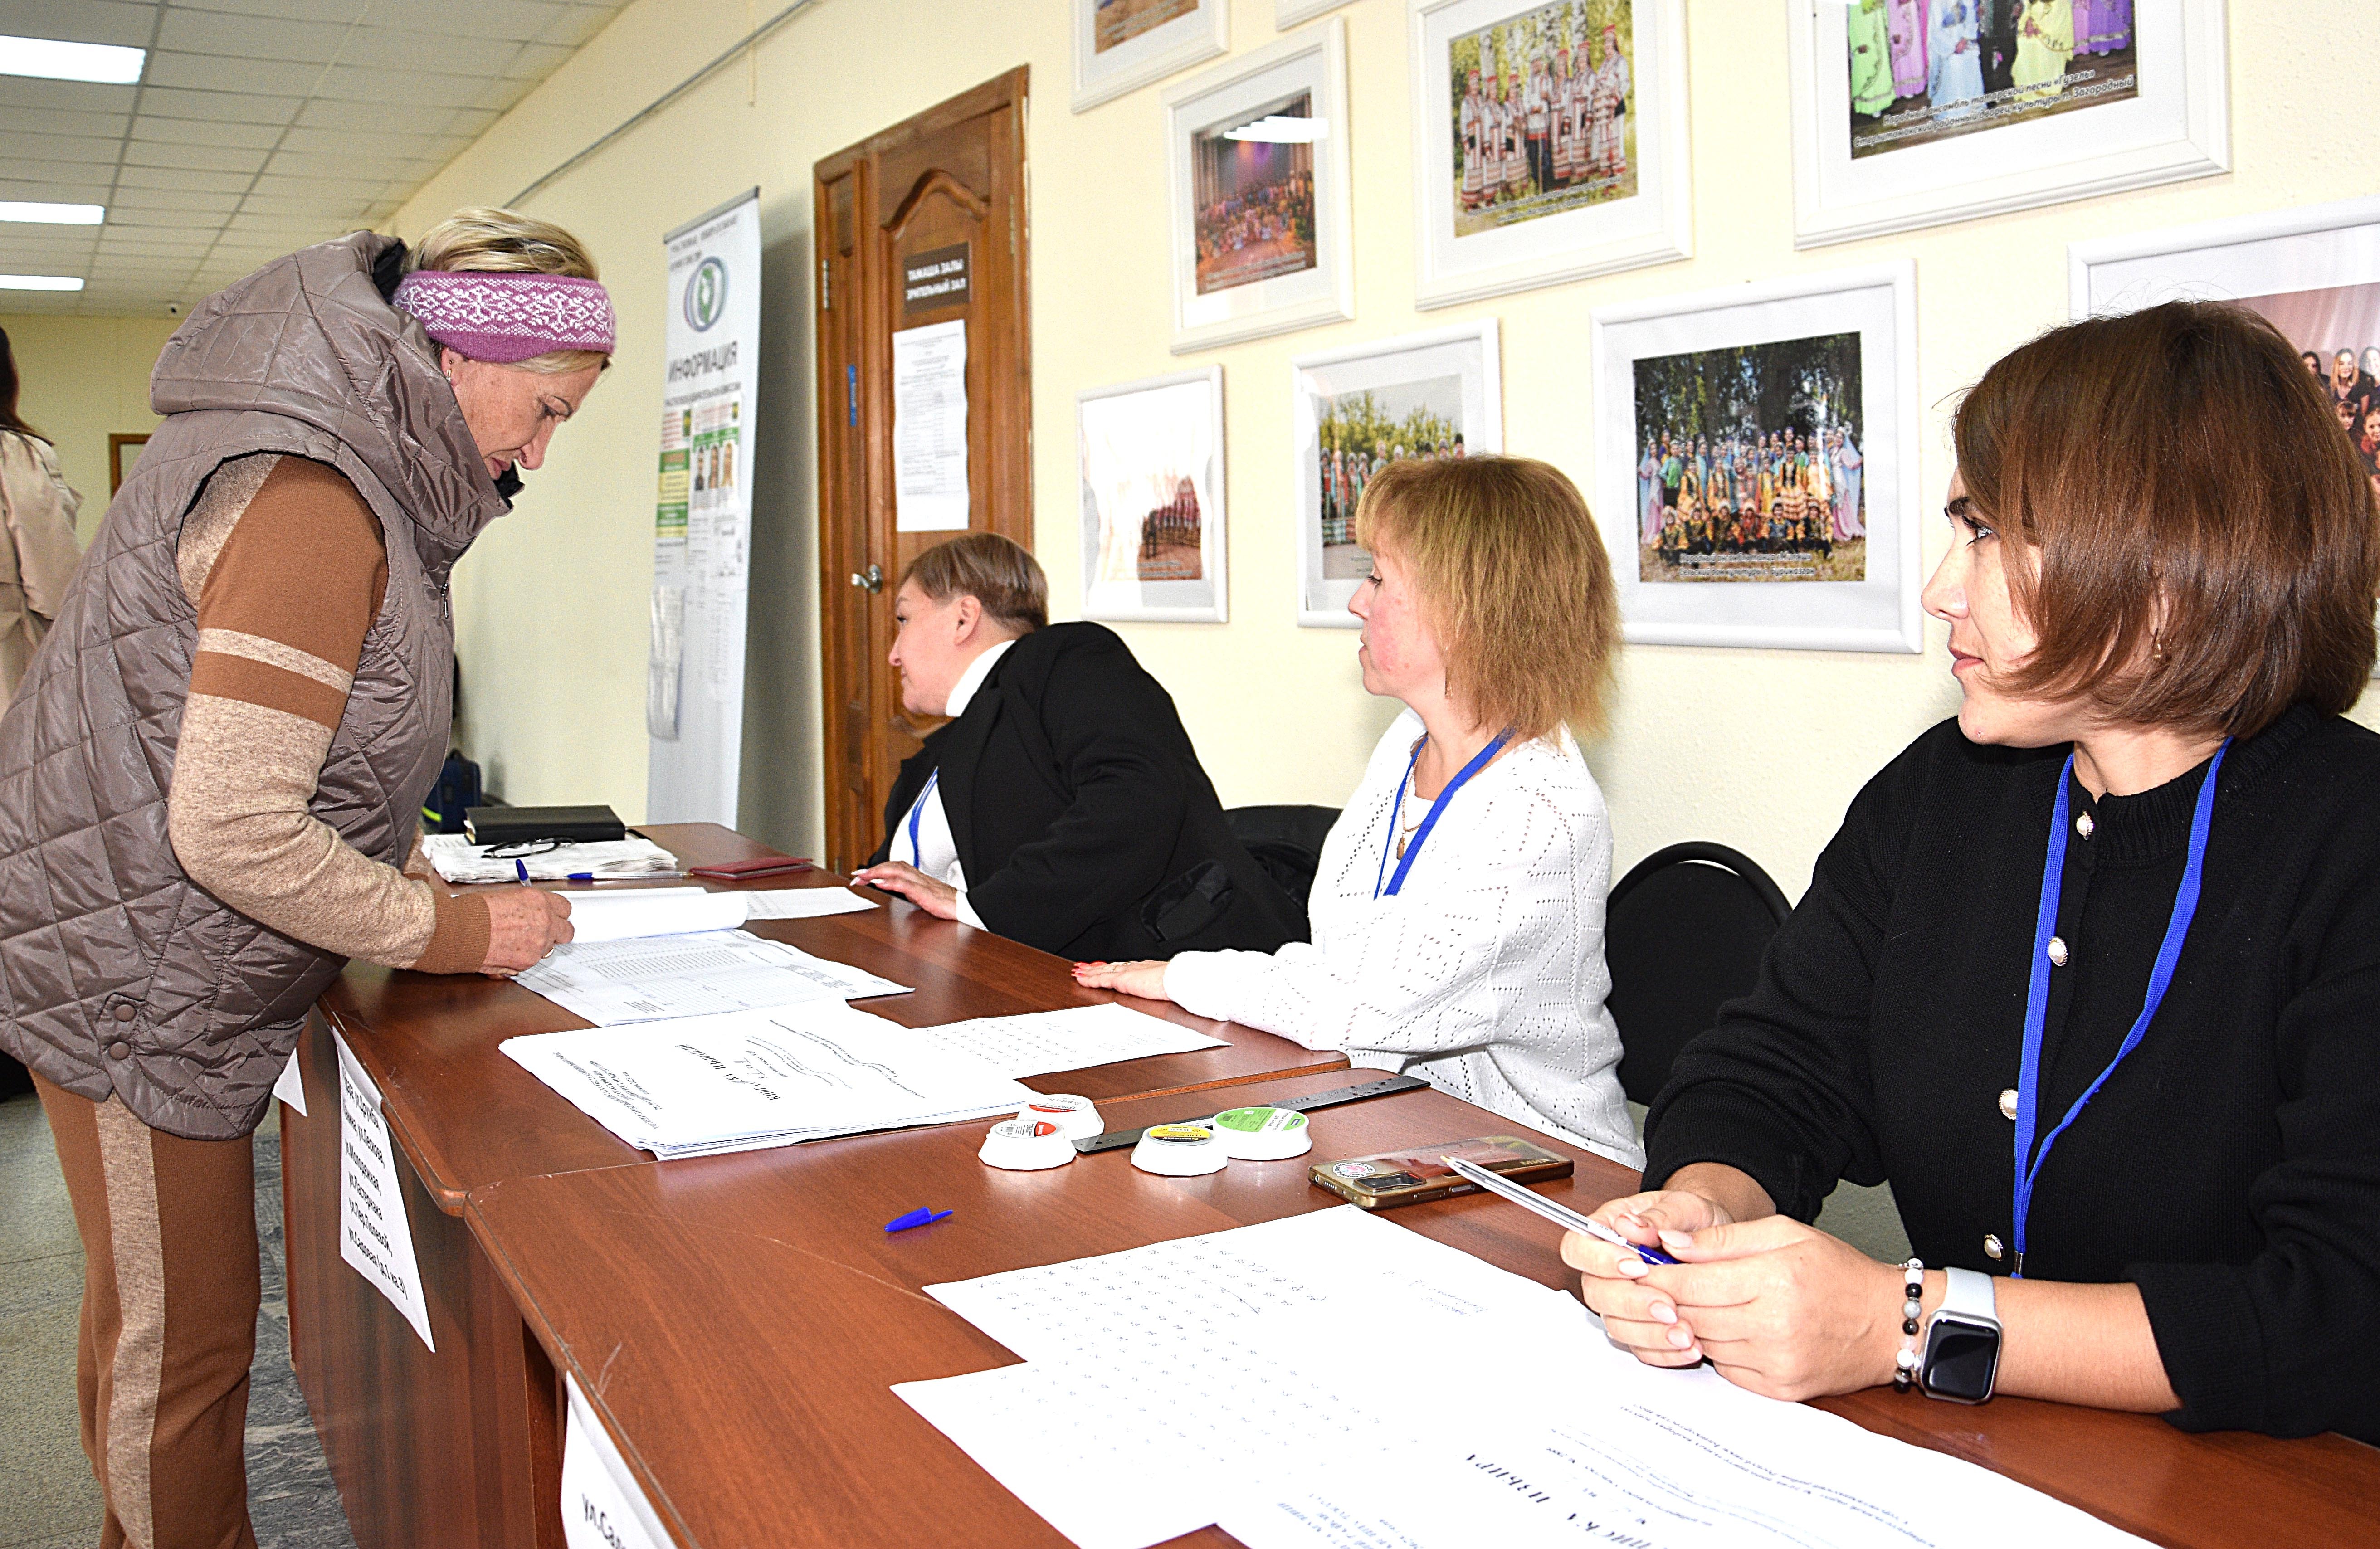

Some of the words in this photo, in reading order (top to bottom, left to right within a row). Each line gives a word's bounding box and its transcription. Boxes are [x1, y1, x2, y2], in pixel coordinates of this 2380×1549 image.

[1883, 106, 1927, 127] Народный
[1972, 84, 2024, 105] татарской
[2026, 80, 2052, 93] песни
[1934, 112, 1977, 132] районный
[1979, 106, 2010, 118] дворец
[2012, 97, 2059, 112] культуры
[2073, 74, 2134, 98] Загородный
[668, 341, 738, 382] ИНФОРМАЦИЯ
